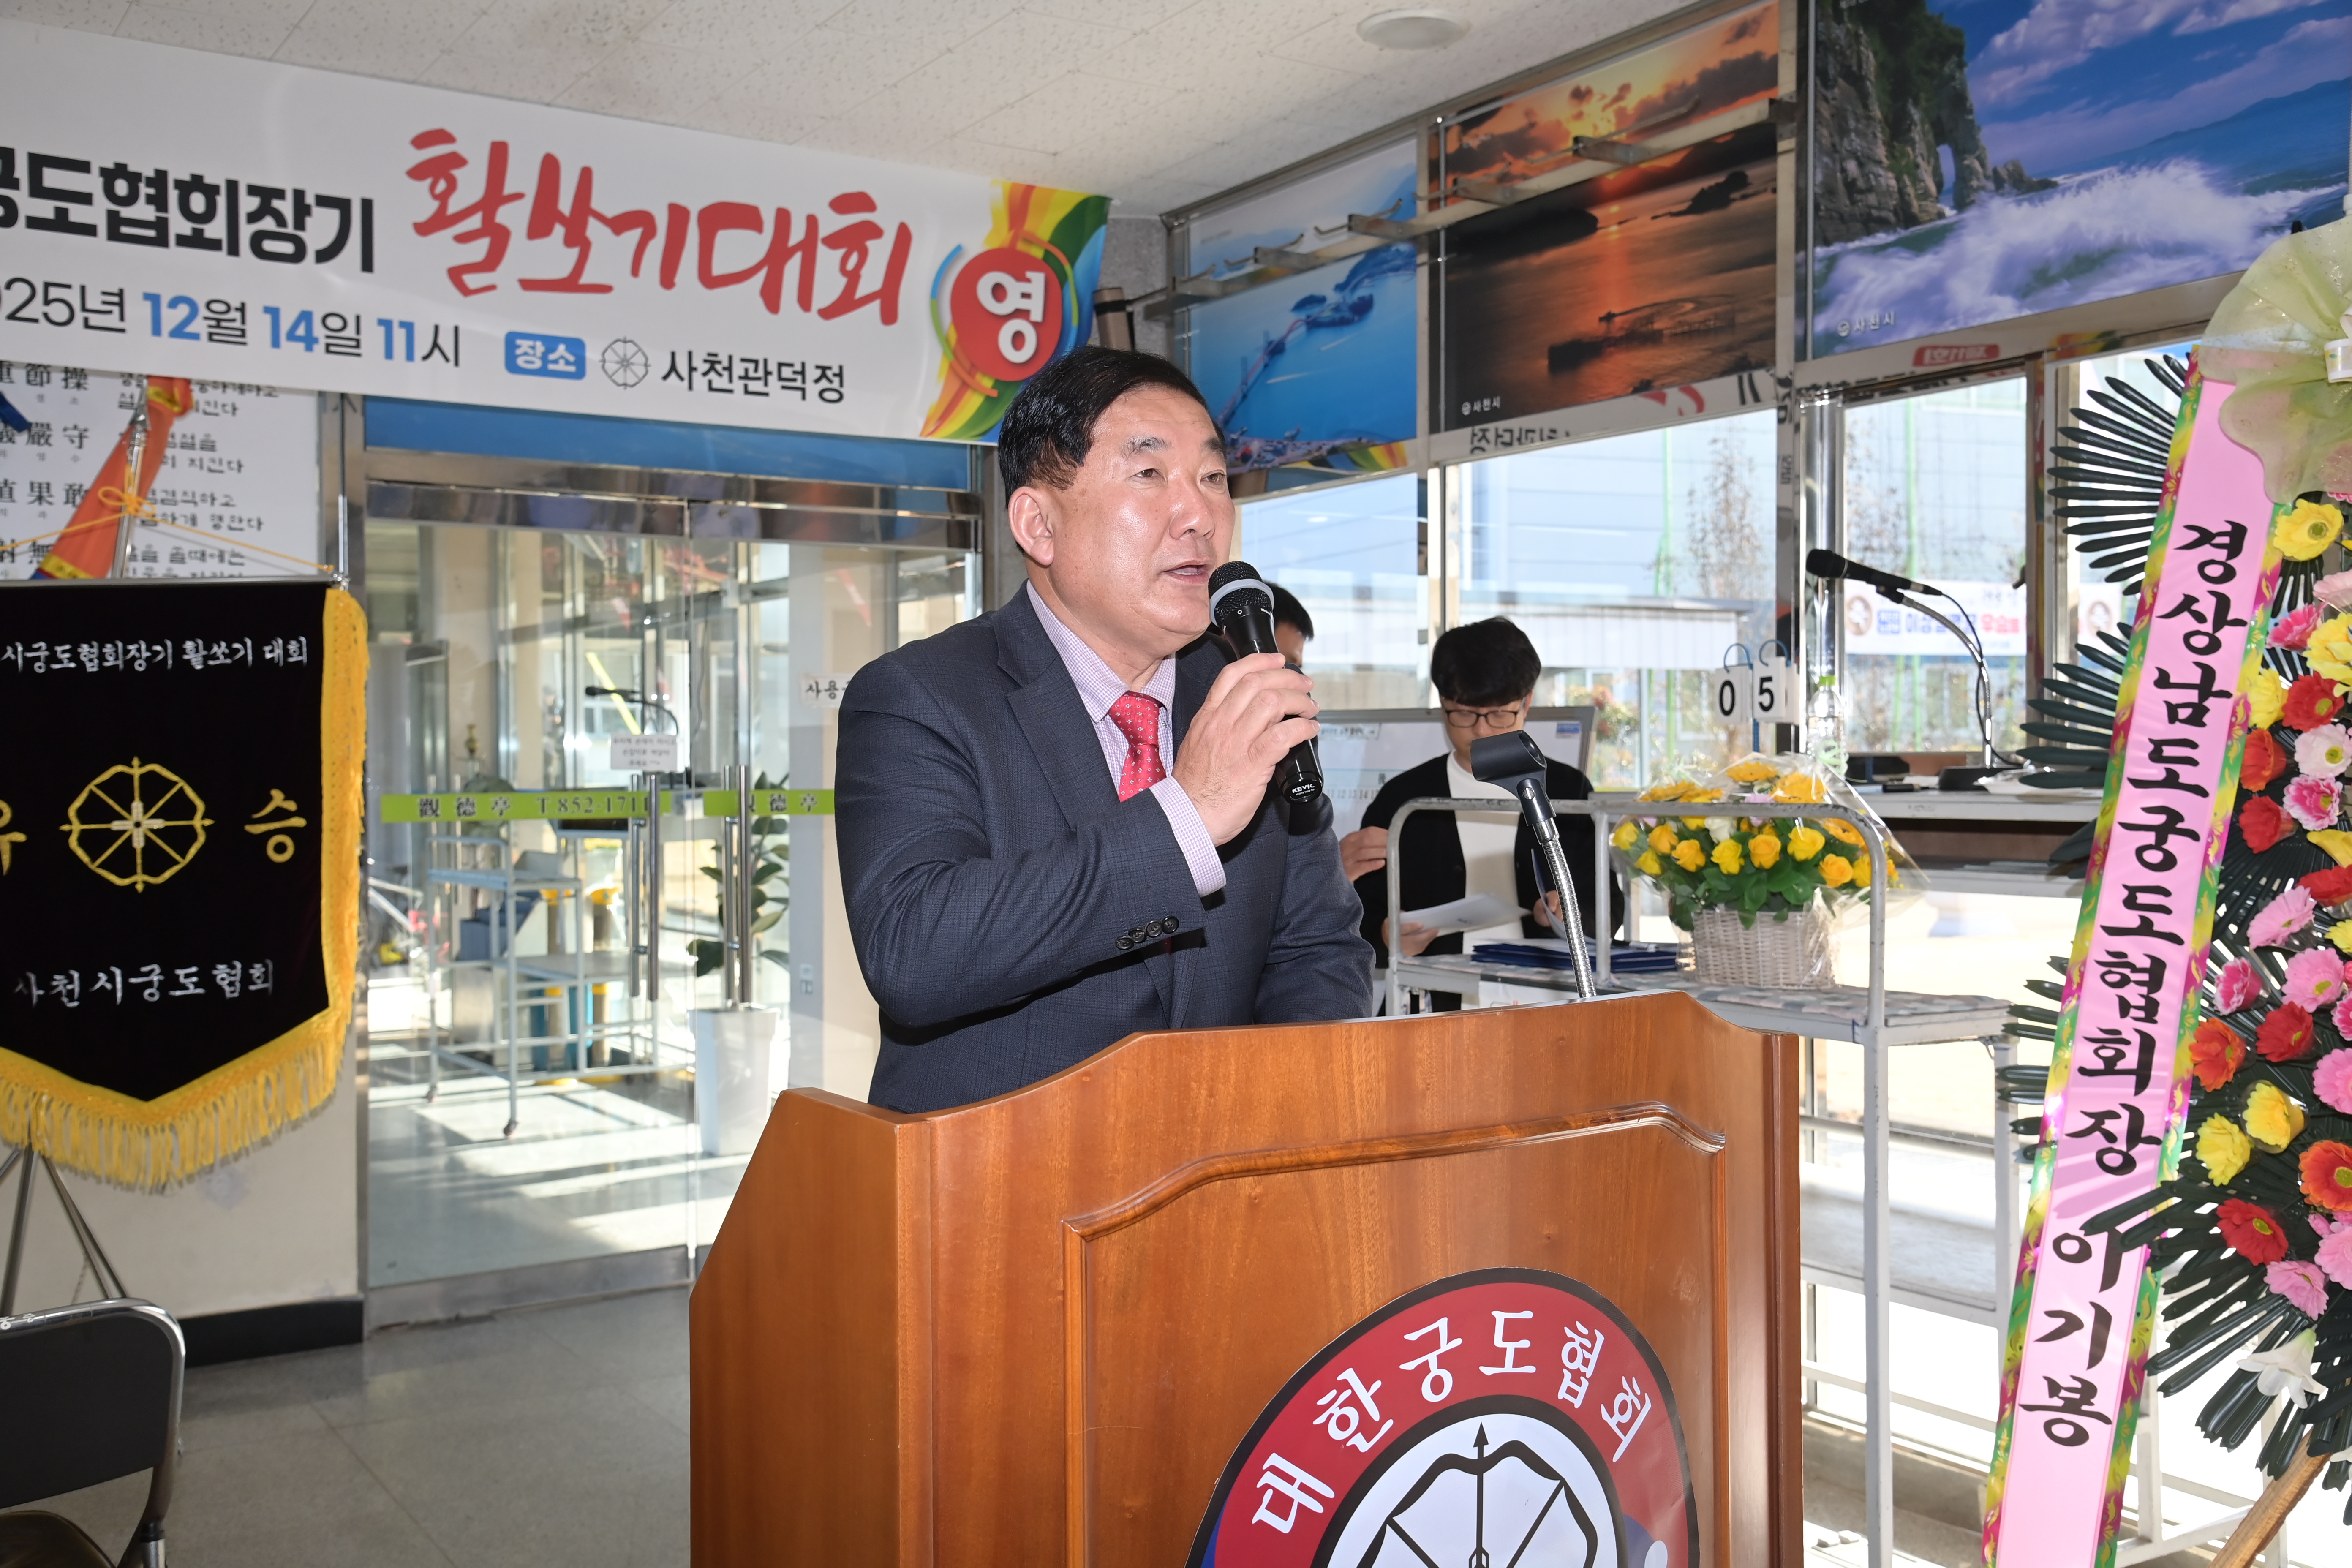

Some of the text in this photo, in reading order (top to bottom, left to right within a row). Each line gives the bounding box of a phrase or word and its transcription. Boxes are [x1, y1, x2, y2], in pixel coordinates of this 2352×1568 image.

[406, 128, 912, 327] 활쏘기대회
[0, 277, 460, 368] 25년 12월 14일 11시
[976, 270, 1046, 364] 영
[1854, 310, 1895, 333] 사천시
[514, 339, 577, 373] 장소
[662, 349, 845, 404] 사천관덕정
[0, 636, 308, 673] 시궁도협회장기 활쏘기 대회
[805, 679, 850, 700] 사용
[749, 792, 817, 813] 德亭
[1292, 784, 1315, 793] KEVIC
[245, 789, 308, 863] 승
[2019, 1223, 2123, 1447] 이기봉
[1251, 1310, 1652, 1534] 대한궁도협회
